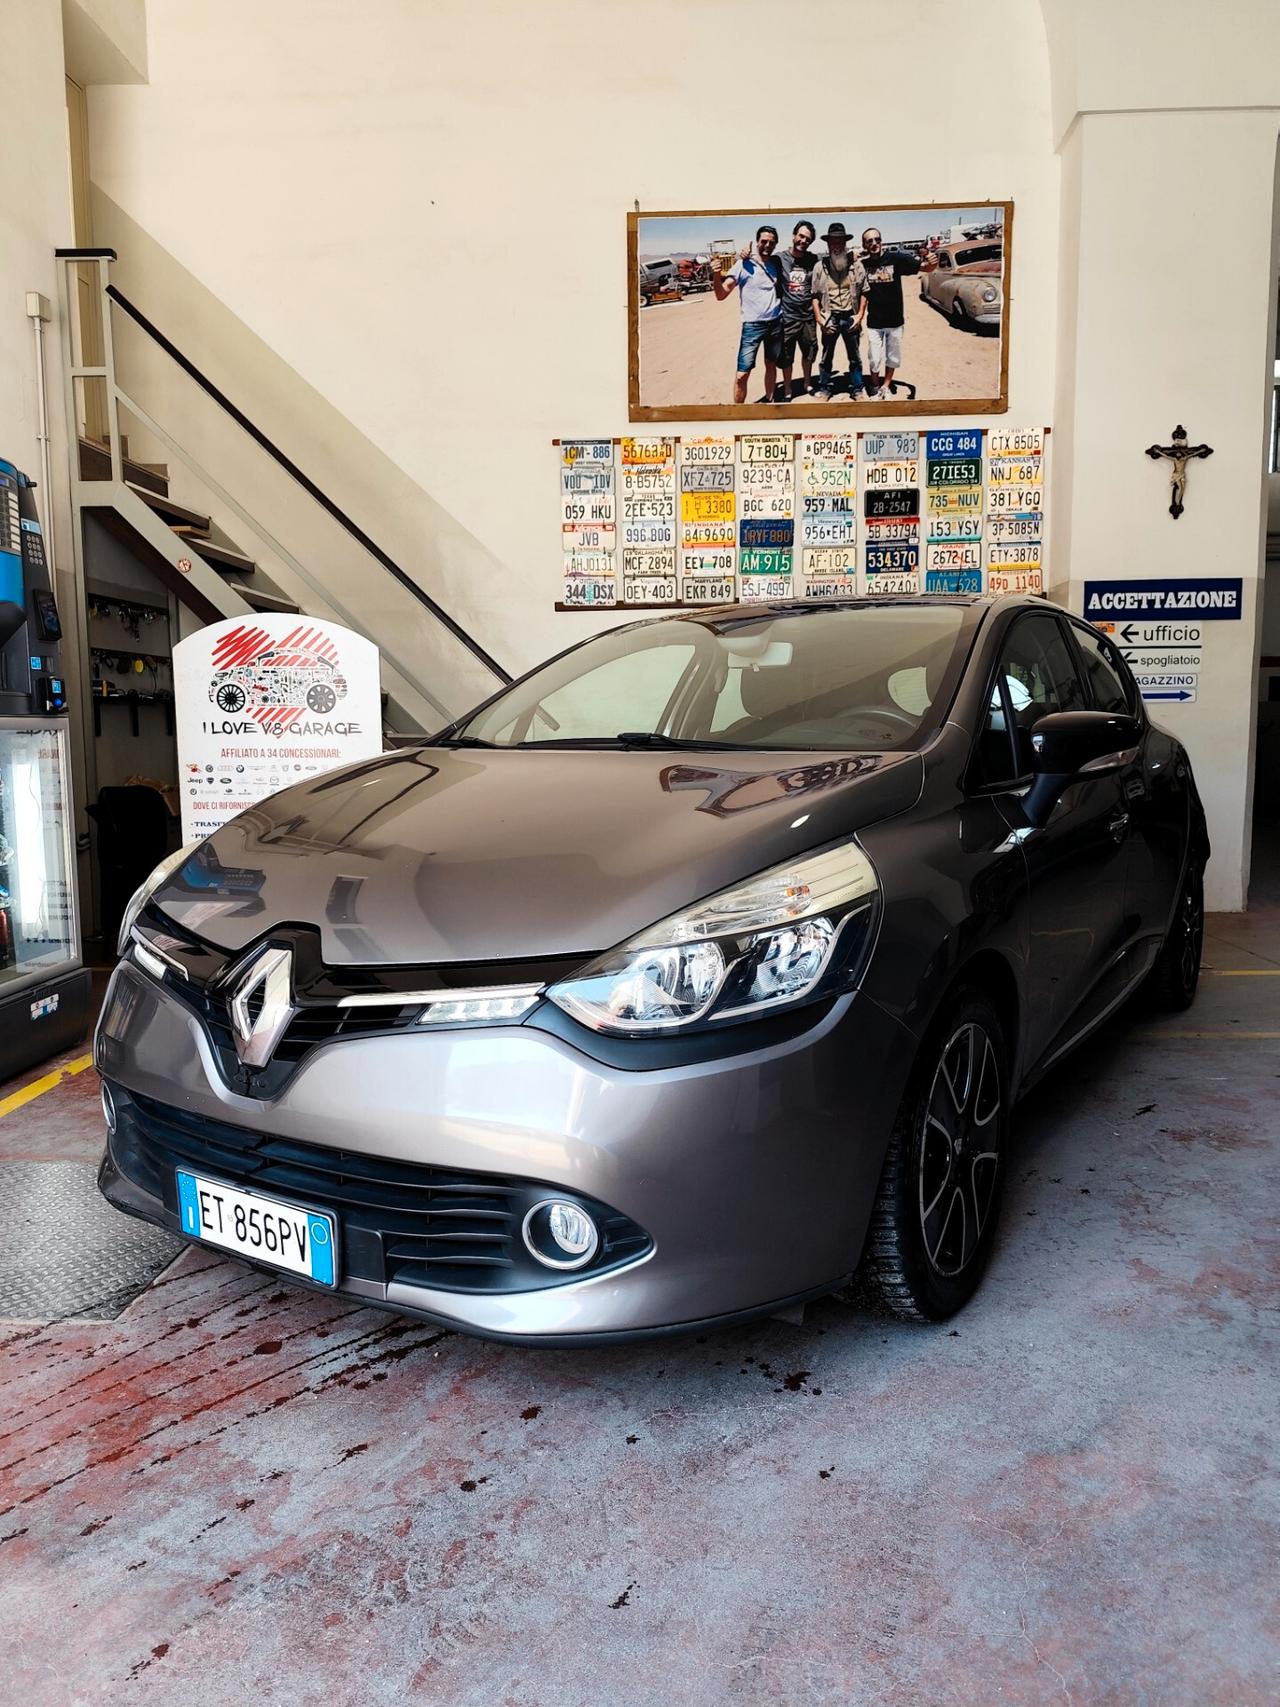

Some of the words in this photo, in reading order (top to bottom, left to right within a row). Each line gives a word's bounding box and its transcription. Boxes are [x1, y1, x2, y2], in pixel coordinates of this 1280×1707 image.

[896, 438, 916, 454] 983
[932, 438, 953, 451] CCG
[957, 437, 976, 450] 484
[1014, 434, 1040, 450] 8505
[1018, 465, 1040, 480] 687
[592, 505, 611, 519] HKU
[771, 498, 791, 512] 620
[578, 532, 599, 546] JVB
[805, 526, 825, 540] 956
[712, 556, 732, 568] 708
[566, 584, 586, 599] 344
[593, 584, 614, 599] DSX
[686, 586, 706, 599] EKR
[710, 584, 731, 598] 849
[1088, 590, 1237, 609] ACCETTAZIONE
[1143, 625, 1200, 641] ufficio
[1140, 655, 1200, 667] spogliatoio
[1136, 676, 1194, 686] AGAZZINO
[202, 721, 206, 734] I
[212, 721, 258, 735] LOVE
[289, 721, 363, 736] GARAGE
[220, 748, 258, 758] AFFILIATO
[260, 748, 266, 758] A
[267, 748, 277, 758] 34
[192, 802, 209, 810] DOVE
[200, 1190, 224, 1233] ET
[234, 1204, 306, 1262] 856PV
